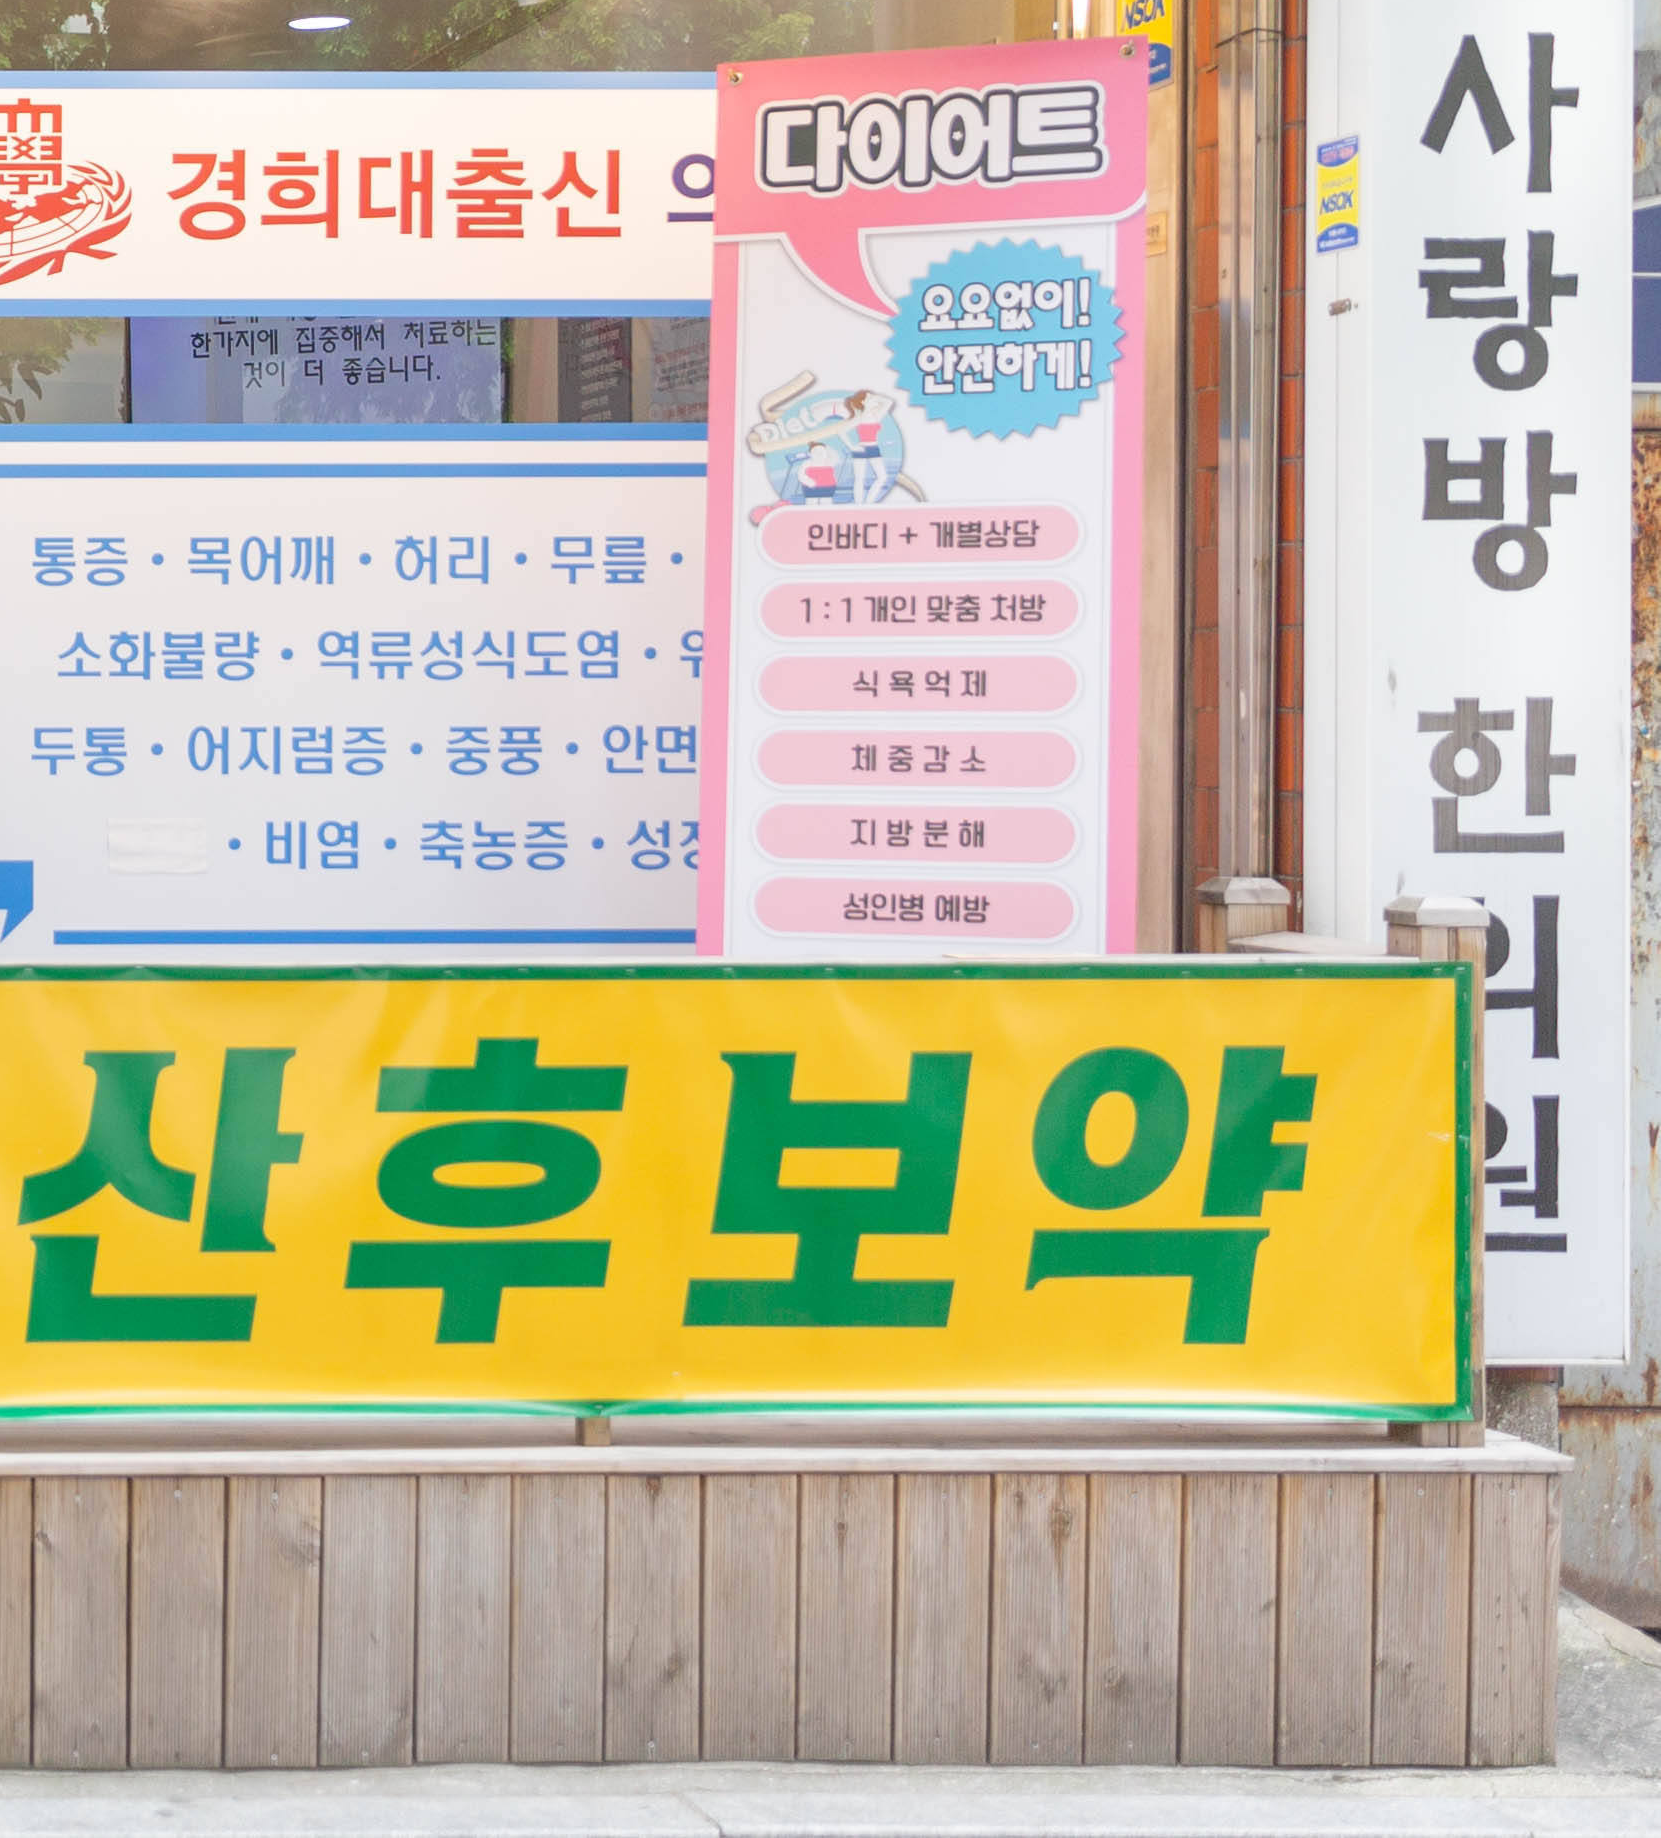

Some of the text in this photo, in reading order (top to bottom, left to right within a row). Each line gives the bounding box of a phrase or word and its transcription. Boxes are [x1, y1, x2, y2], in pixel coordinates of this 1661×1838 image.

[759, 82, 1106, 194] 다이어트
[166, 148, 622, 240] 경희대출신
[918, 277, 1092, 332] 요요없이!
[1416, 30, 1579, 592] 사랑방
[190, 329, 278, 358] 한가지에
[295, 325, 386, 355] 집중해서
[916, 339, 1092, 395] 안전하게!
[243, 355, 441, 388] 것이 더 좋습니다.
[32, 535, 647, 586] 통증 목어깨 허리 무릎
[808, 522, 888, 551] 인바디
[930, 519, 1040, 549] 개별상담
[864, 595, 917, 624] 개인
[927, 595, 982, 624] 맞춤
[989, 593, 1047, 623] 처방
[57, 629, 260, 681] 소화불량
[316, 629, 620, 681] 역류성식도염
[852, 670, 988, 698] 식욕억제
[29, 725, 128, 776] 두통
[186, 725, 387, 776] 어지럼증
[444, 725, 543, 776] 중풍
[851, 745, 987, 773] 체중감소
[265, 820, 361, 870] 비염
[418, 819, 569, 870] 축농증
[851, 819, 986, 848] 지방분해
[843, 892, 990, 924] 성인병 예방
[17, 1036, 1318, 1346] 산후보약
